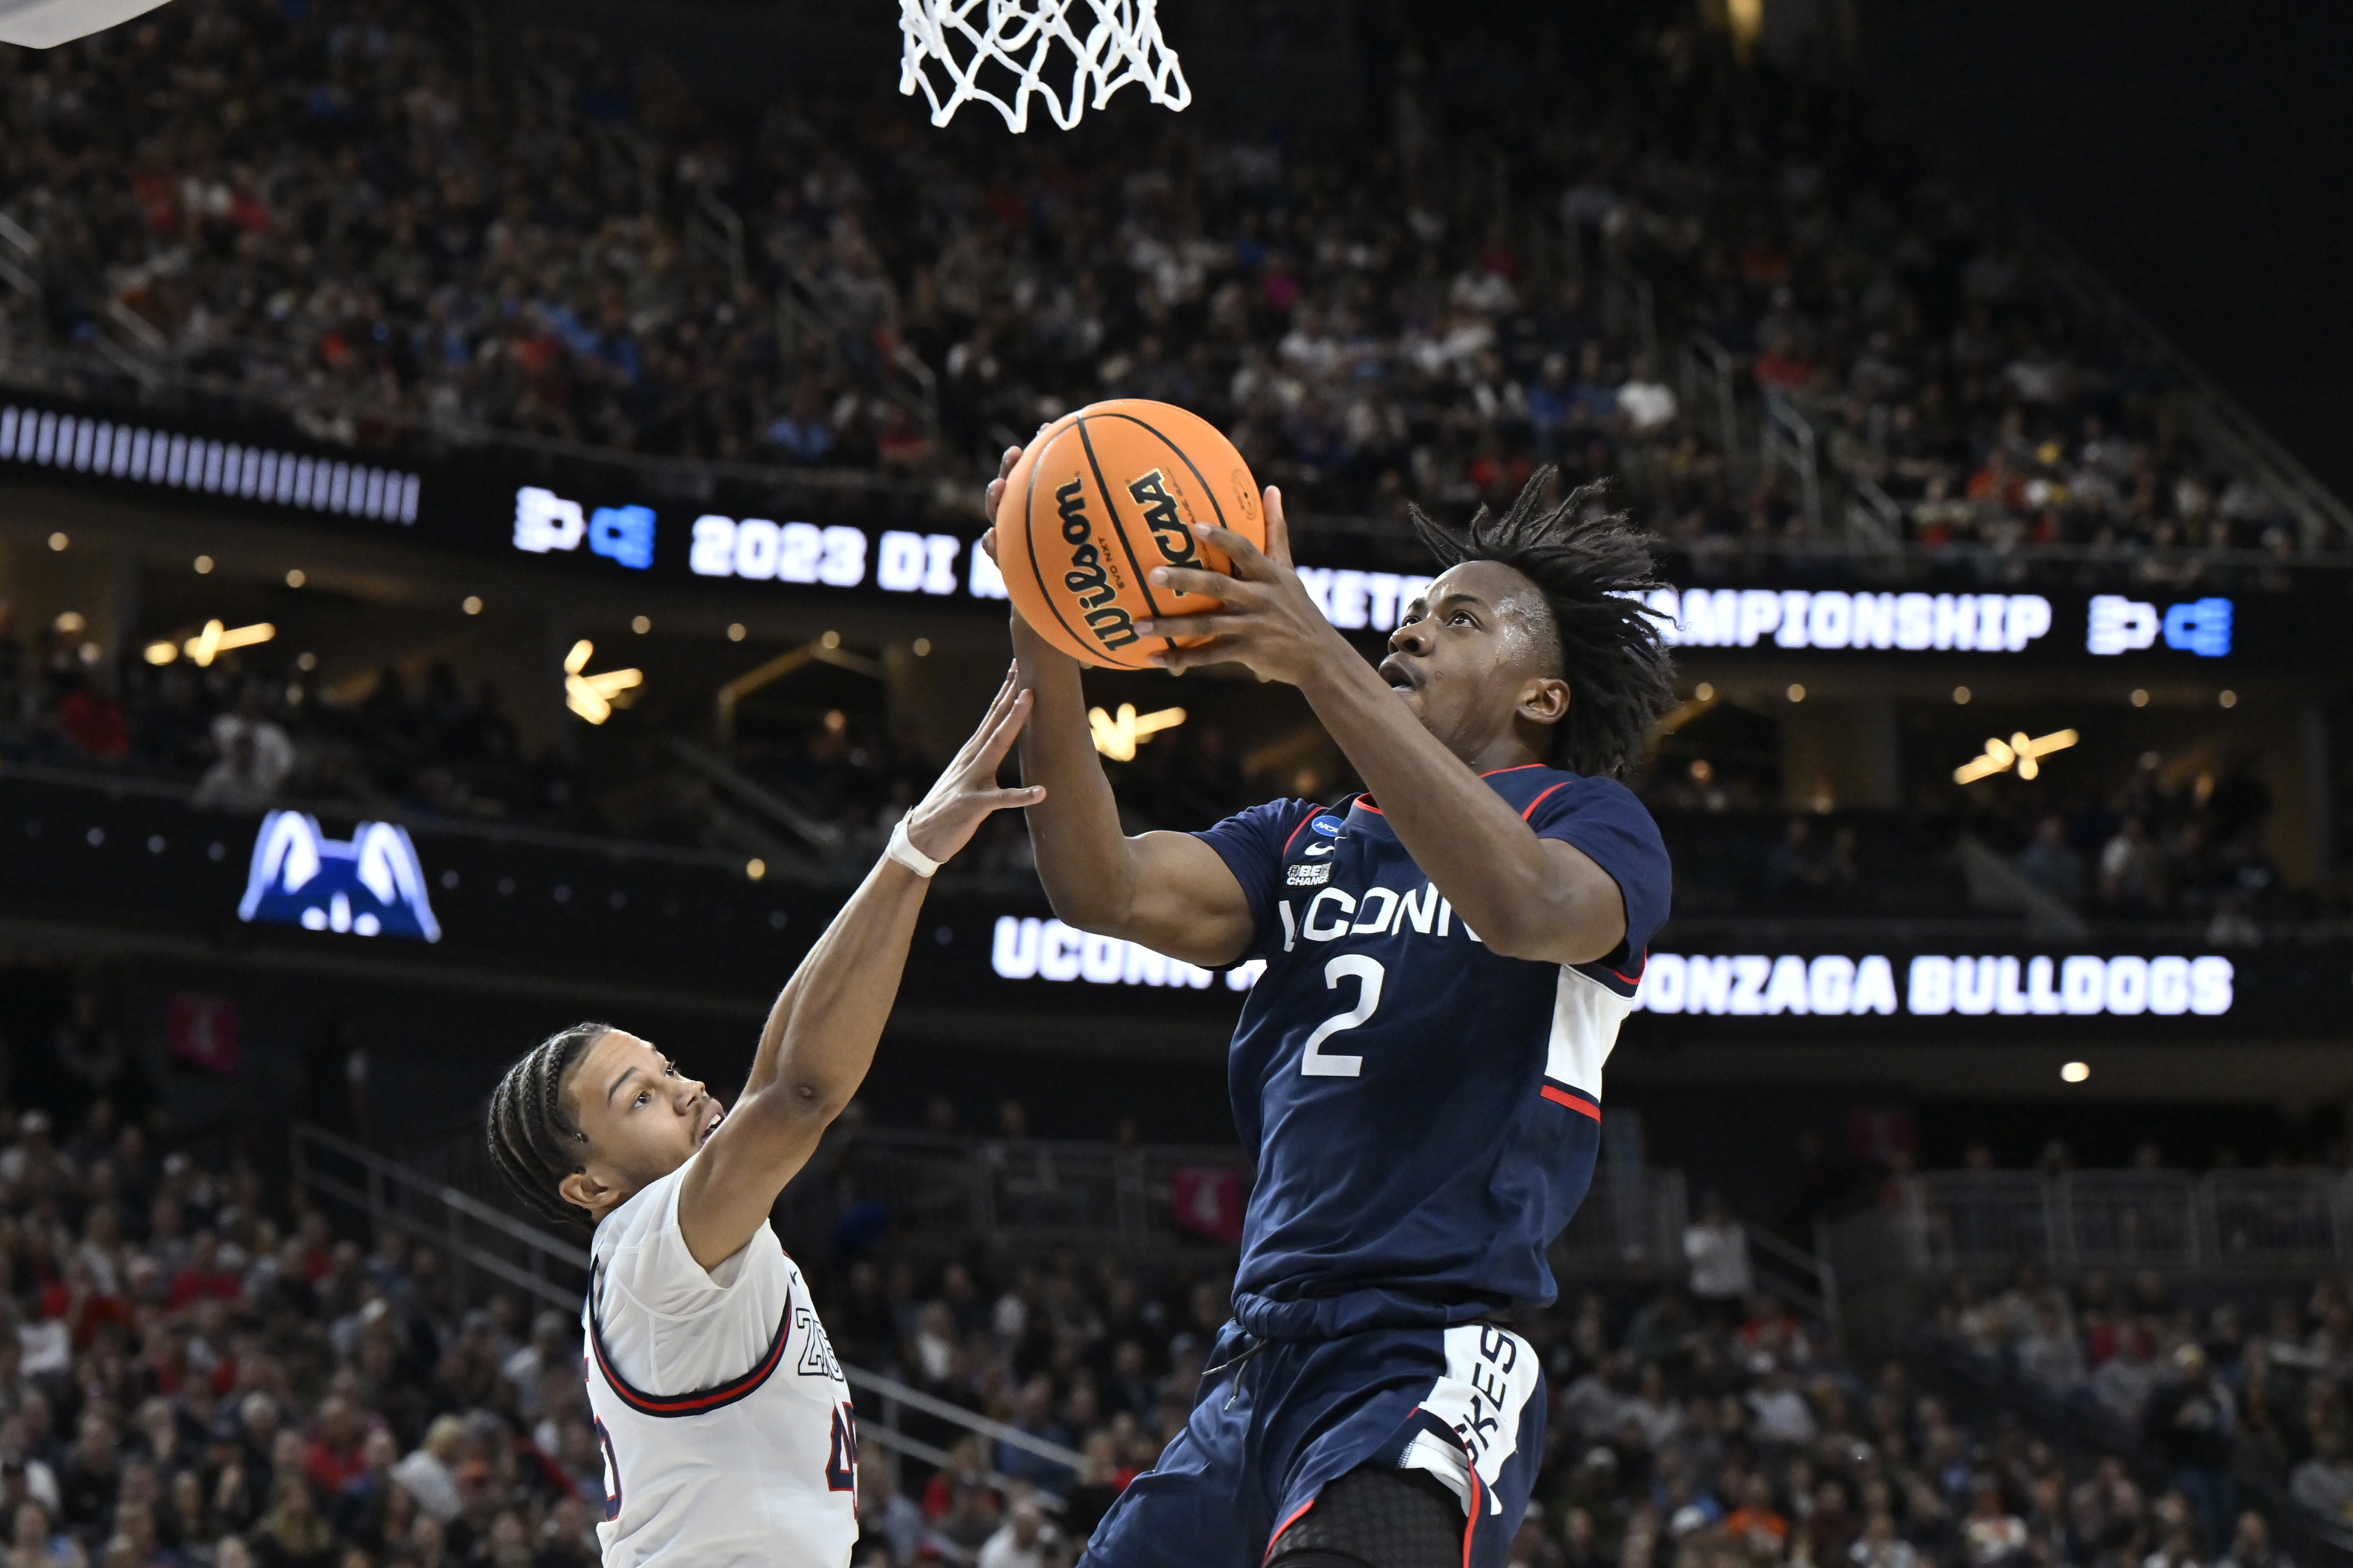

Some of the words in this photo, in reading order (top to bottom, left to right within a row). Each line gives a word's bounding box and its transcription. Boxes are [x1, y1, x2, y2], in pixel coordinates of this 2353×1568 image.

[1181, 499, 1197, 524] AME
[690, 514, 867, 587] 2023
[1608, 588, 2052, 651] AMPIONSHIP
[1055, 476, 1140, 652] Wilson
[1286, 874, 1329, 886] CHANGE
[1301, 954, 1386, 1077] 2
[1908, 955, 2234, 1016] BULLDOGS
